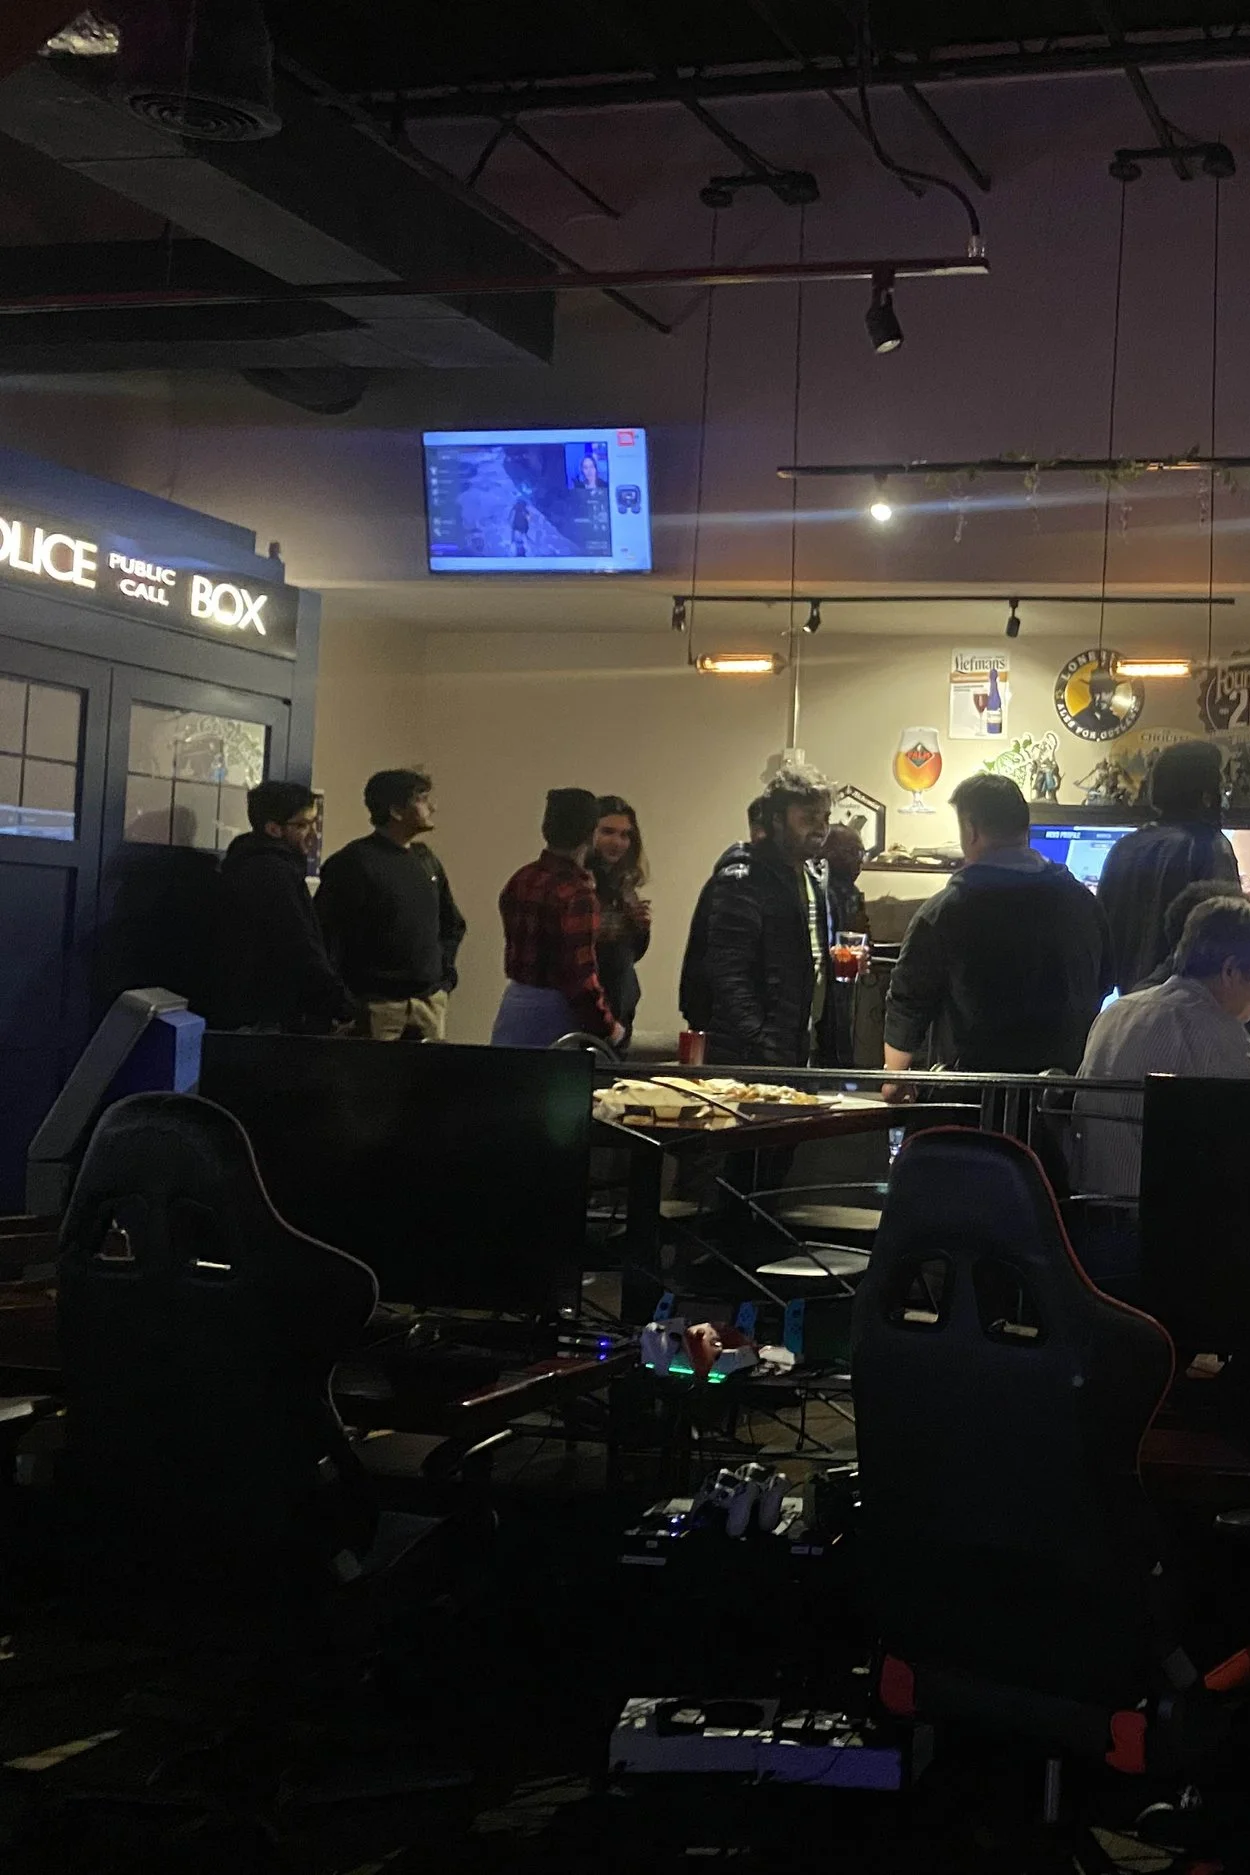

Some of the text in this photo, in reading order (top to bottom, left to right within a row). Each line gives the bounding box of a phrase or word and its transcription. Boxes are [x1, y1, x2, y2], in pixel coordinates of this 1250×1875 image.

[0, 516, 98, 590] LICE
[109, 552, 176, 587] PUBLIC
[119, 578, 169, 606] CALL
[190, 575, 268, 636] BOX
[955, 653, 1006, 674] Liefmans
[1056, 703, 1076, 728] ALES
[1075, 726, 1097, 739] FOR
